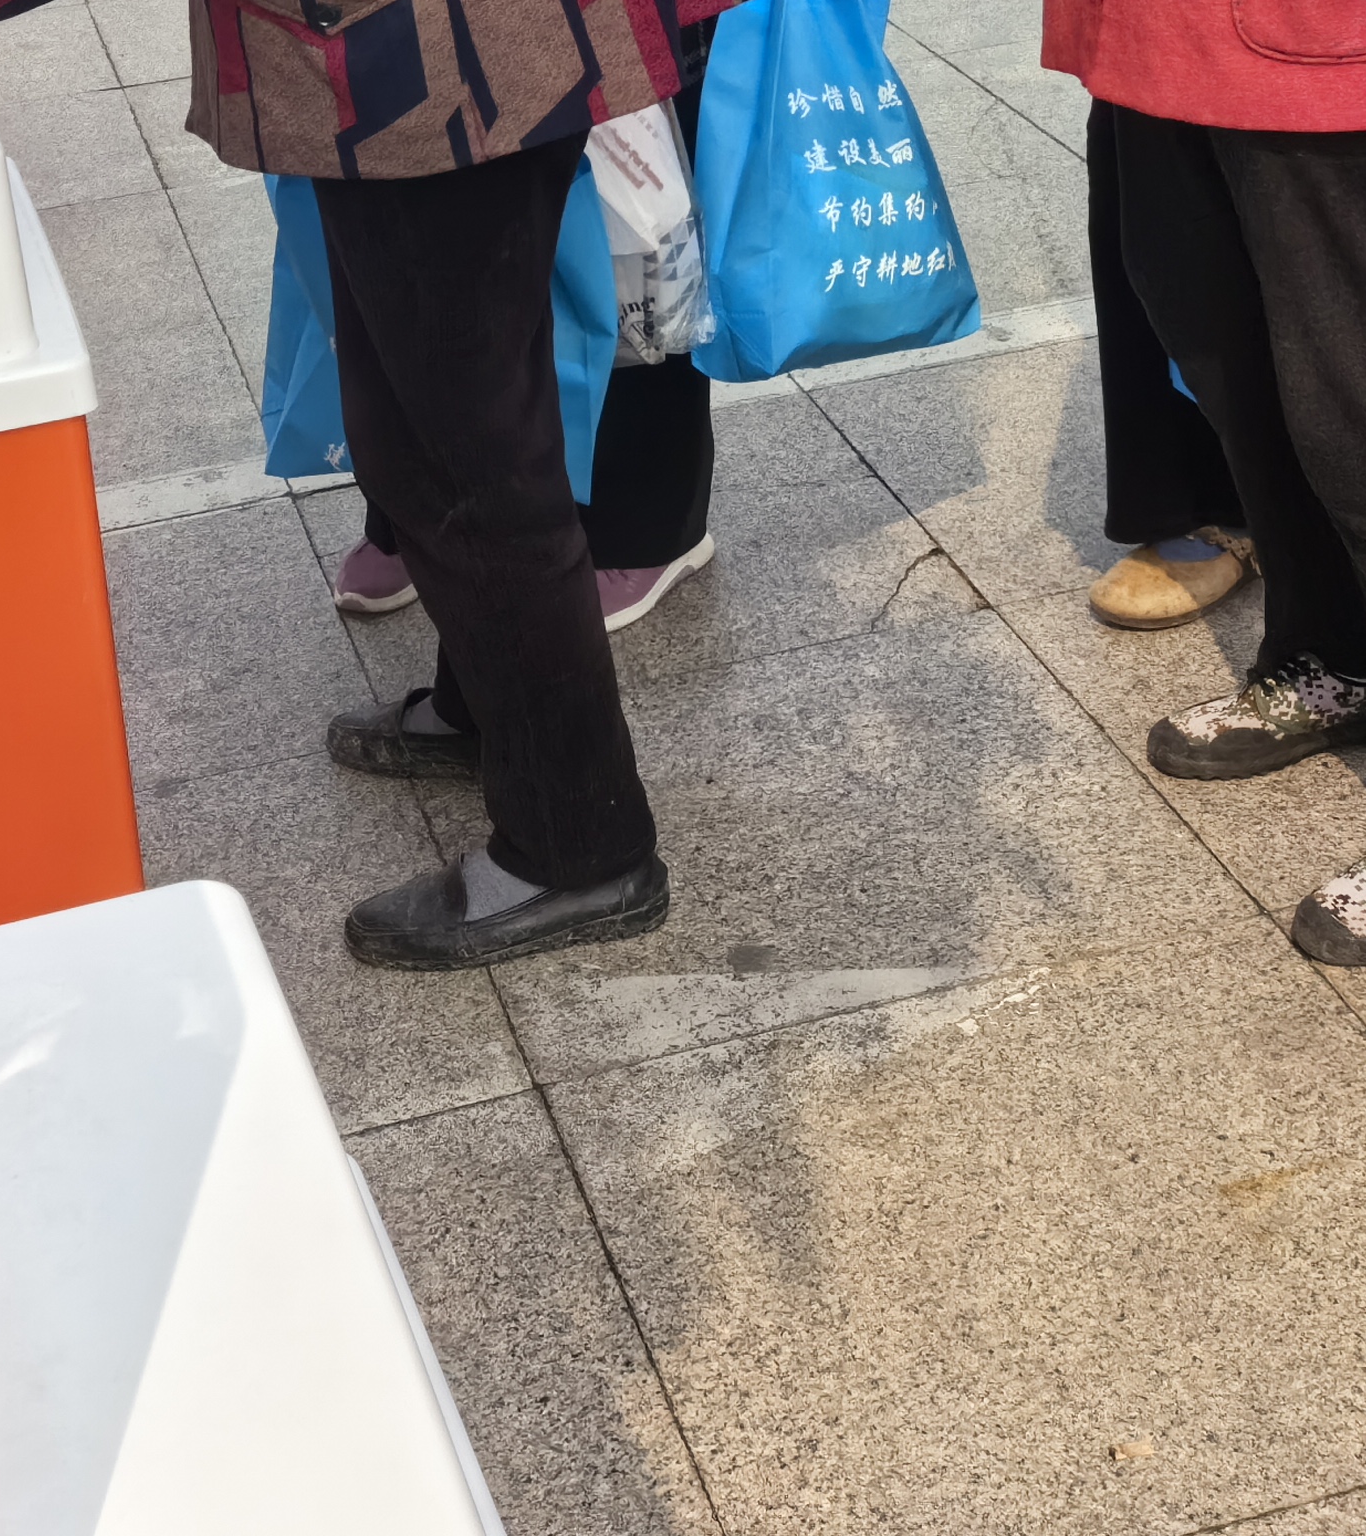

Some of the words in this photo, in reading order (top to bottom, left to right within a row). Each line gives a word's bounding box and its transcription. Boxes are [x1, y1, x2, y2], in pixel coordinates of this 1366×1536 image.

[787, 79, 903, 118] 珍惜自然
[804, 137, 914, 174] 建设美丽
[819, 191, 937, 233] 节约集约
